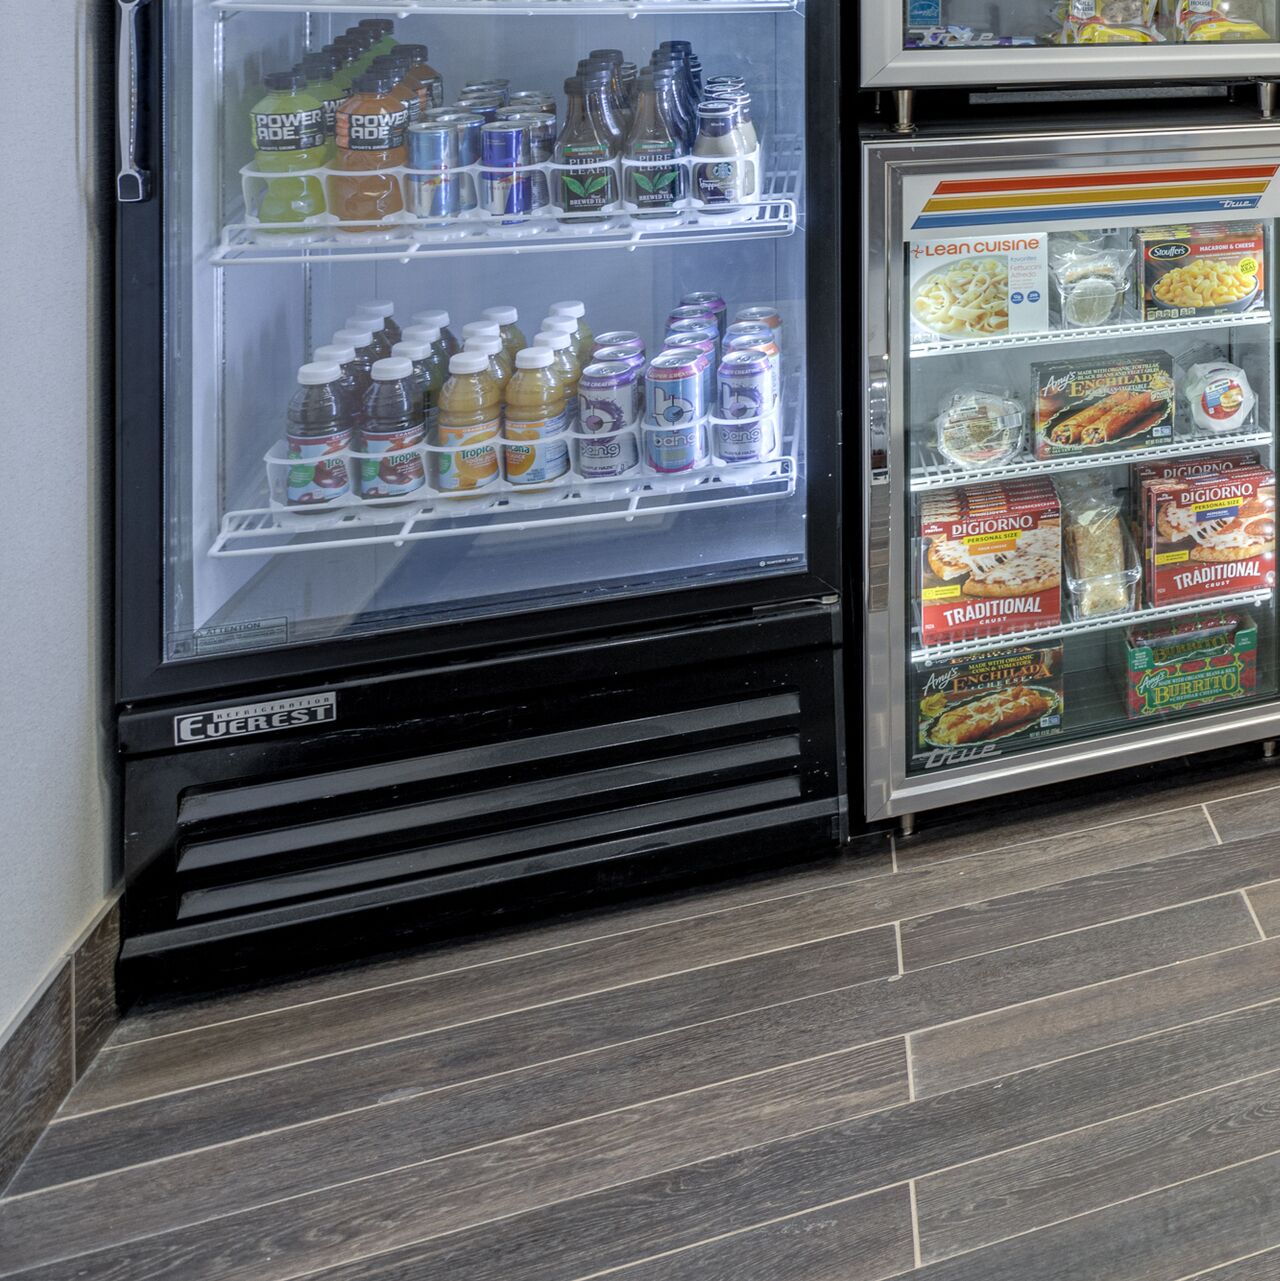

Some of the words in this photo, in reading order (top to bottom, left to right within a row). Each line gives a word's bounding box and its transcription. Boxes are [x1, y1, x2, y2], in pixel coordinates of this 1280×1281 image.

[256, 110, 322, 128] POWER
[351, 110, 409, 127] POWER
[352, 127, 390, 140] ADE
[1153, 246, 1186, 258] Stouffer's
[1040, 370, 1077, 397] Amy's
[1194, 502, 1226, 511] PERSONAL
[967, 534, 1003, 543] PERSONAL
[1003, 531, 1018, 539] SIZE
[1173, 561, 1261, 590] TRADITIONAL
[1205, 580, 1230, 589] CRUST
[944, 596, 1042, 627] TRADITIONAL
[979, 616, 1008, 625] CRUST
[922, 666, 961, 697] Amy's
[953, 663, 1053, 694] ENCHILADA
[1154, 672, 1237, 705] BURRITO
